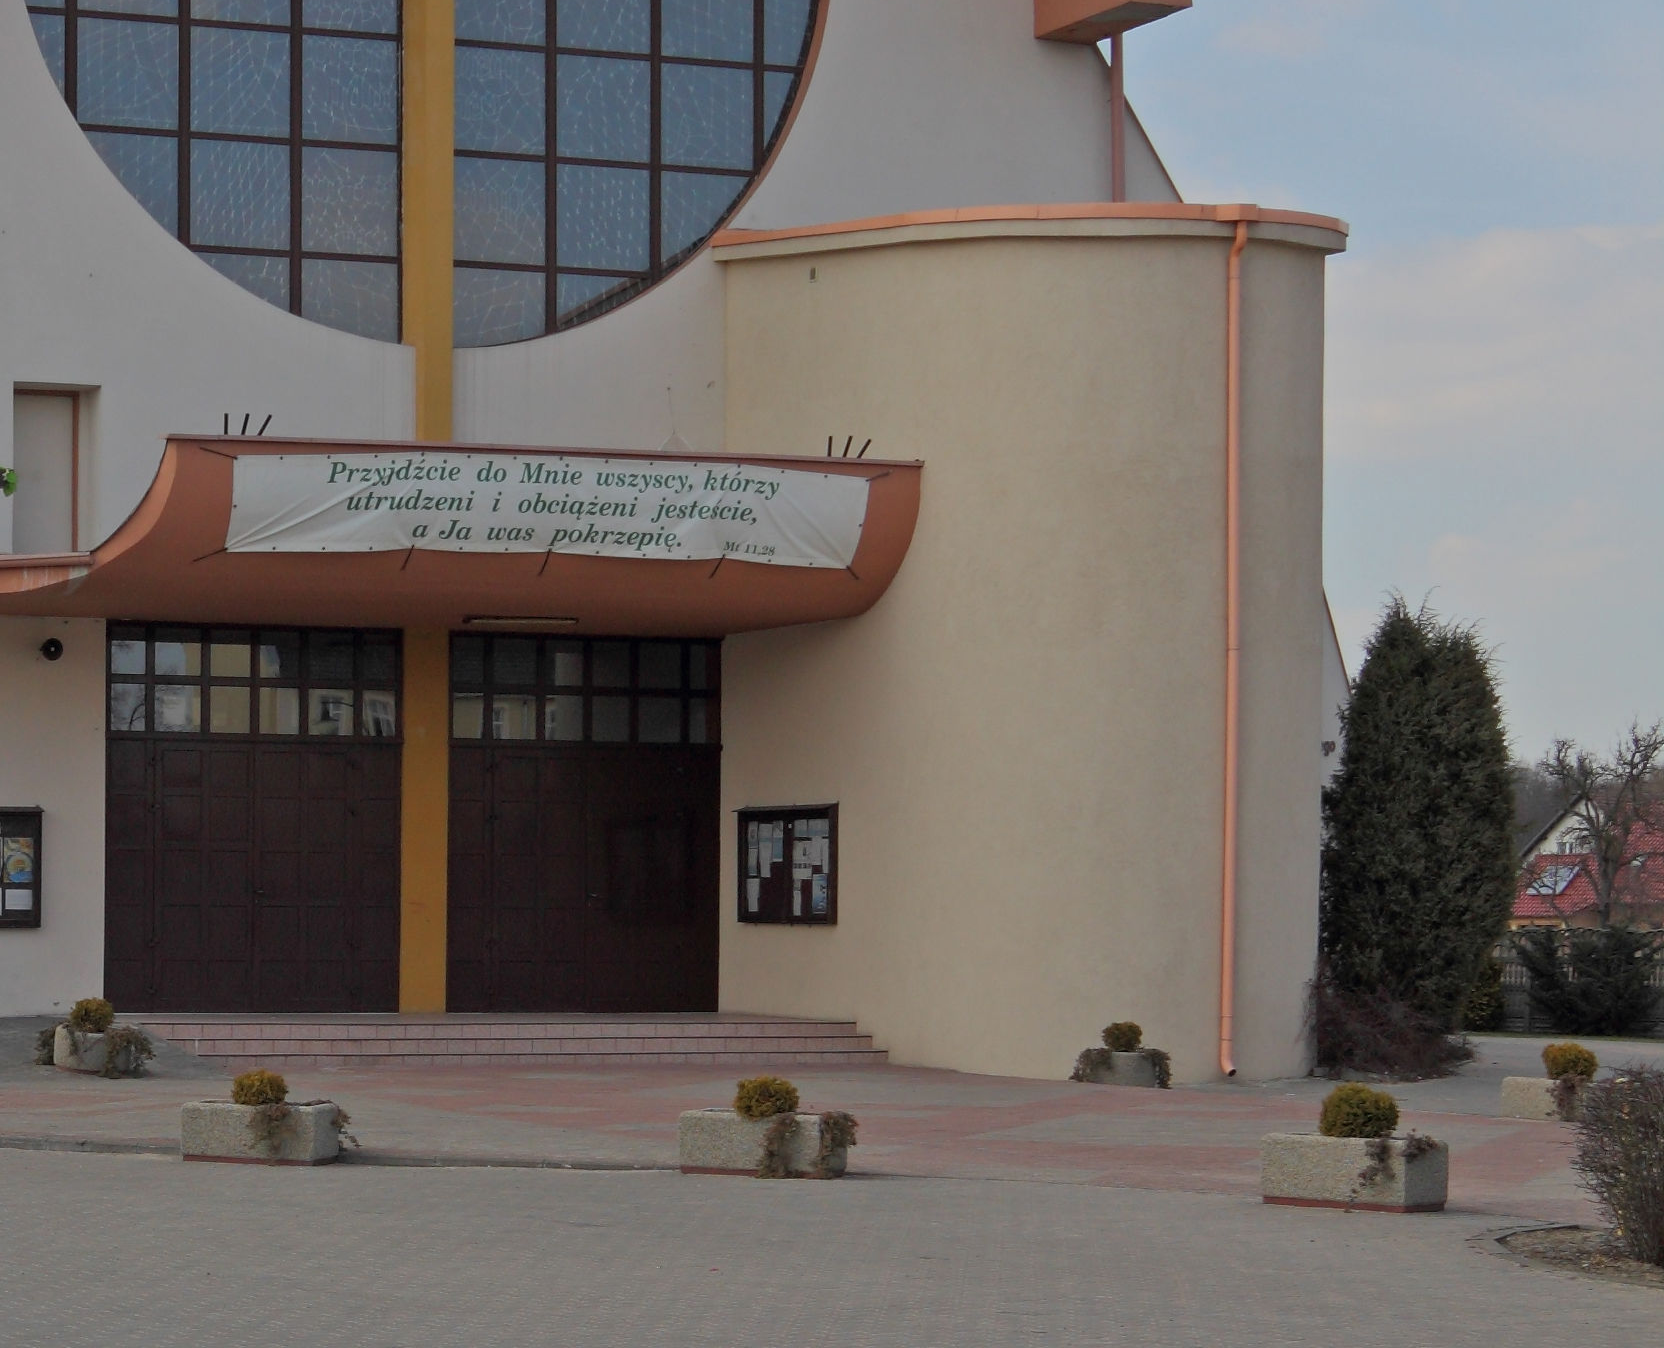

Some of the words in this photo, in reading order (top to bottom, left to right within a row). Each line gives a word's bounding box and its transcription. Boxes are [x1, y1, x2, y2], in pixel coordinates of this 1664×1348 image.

[327, 459, 461, 486] Przyjdźcie
[477, 460, 507, 483] do
[520, 462, 583, 486] Mnie
[596, 470, 693, 494] wszyscy,
[703, 469, 780, 501] którzy
[346, 488, 474, 512] utrudzeni
[491, 491, 502, 513] i
[518, 493, 638, 521] obciążeni
[651, 497, 758, 525] jesteście,
[412, 523, 428, 538] a
[439, 519, 473, 541] Ja
[487, 526, 535, 542] was
[548, 523, 682, 553] pokrzepię.
[723, 541, 740, 552] Mt
[743, 544, 776, 556] 11,28
